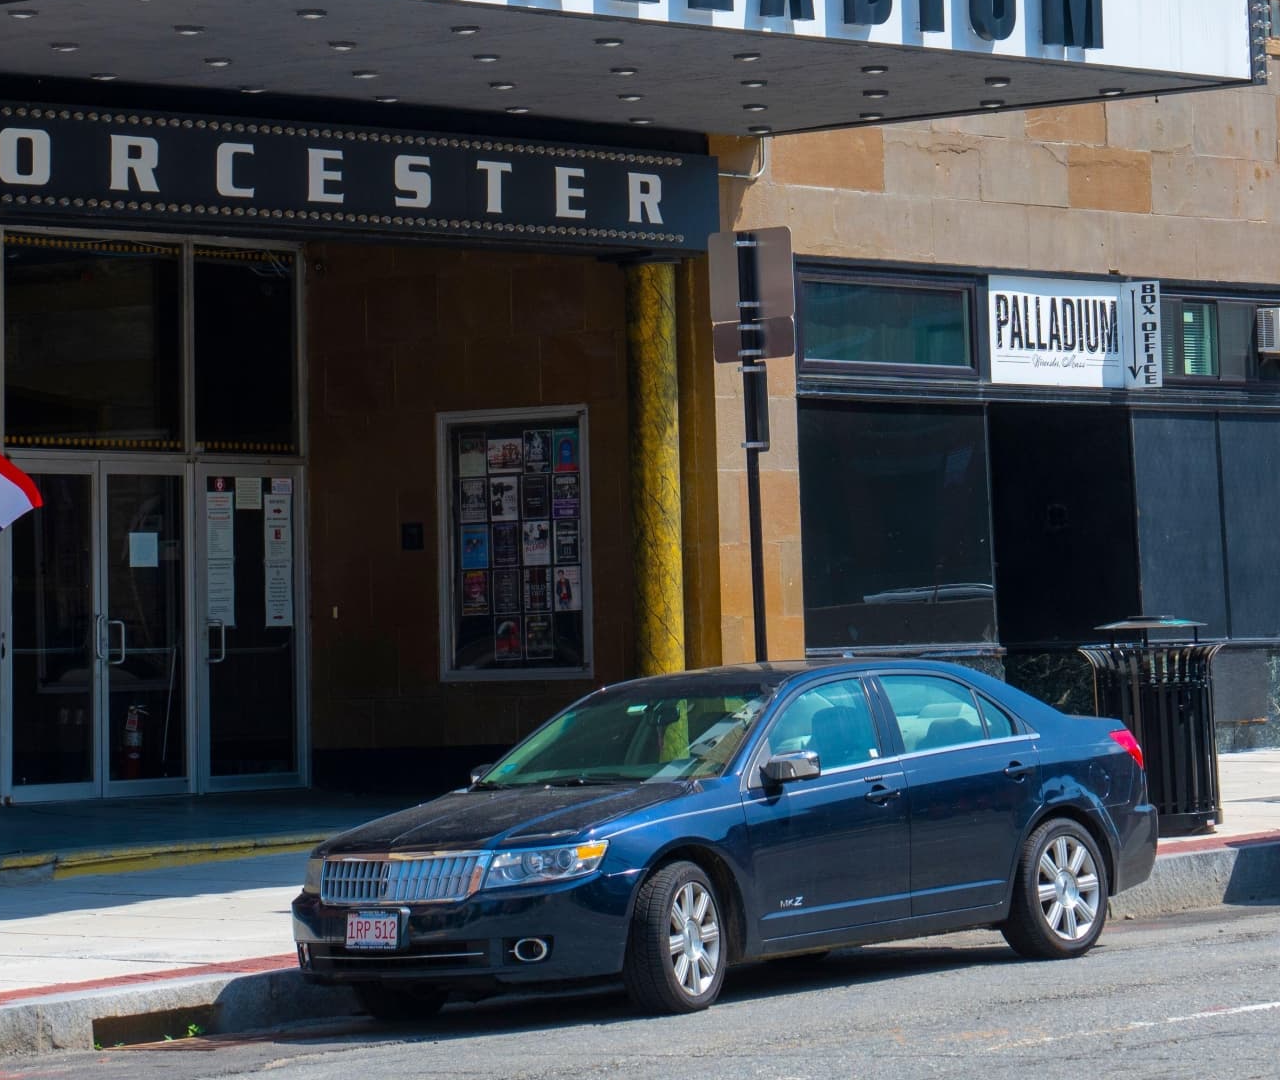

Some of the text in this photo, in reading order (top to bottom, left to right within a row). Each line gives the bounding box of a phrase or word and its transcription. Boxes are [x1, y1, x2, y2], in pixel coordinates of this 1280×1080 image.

[995, 294, 1119, 354] PALLADIUM
[1141, 284, 1157, 385] BOX OFFICE
[780, 896, 803, 909] MKZ
[347, 920, 396, 939] 1RP 512
